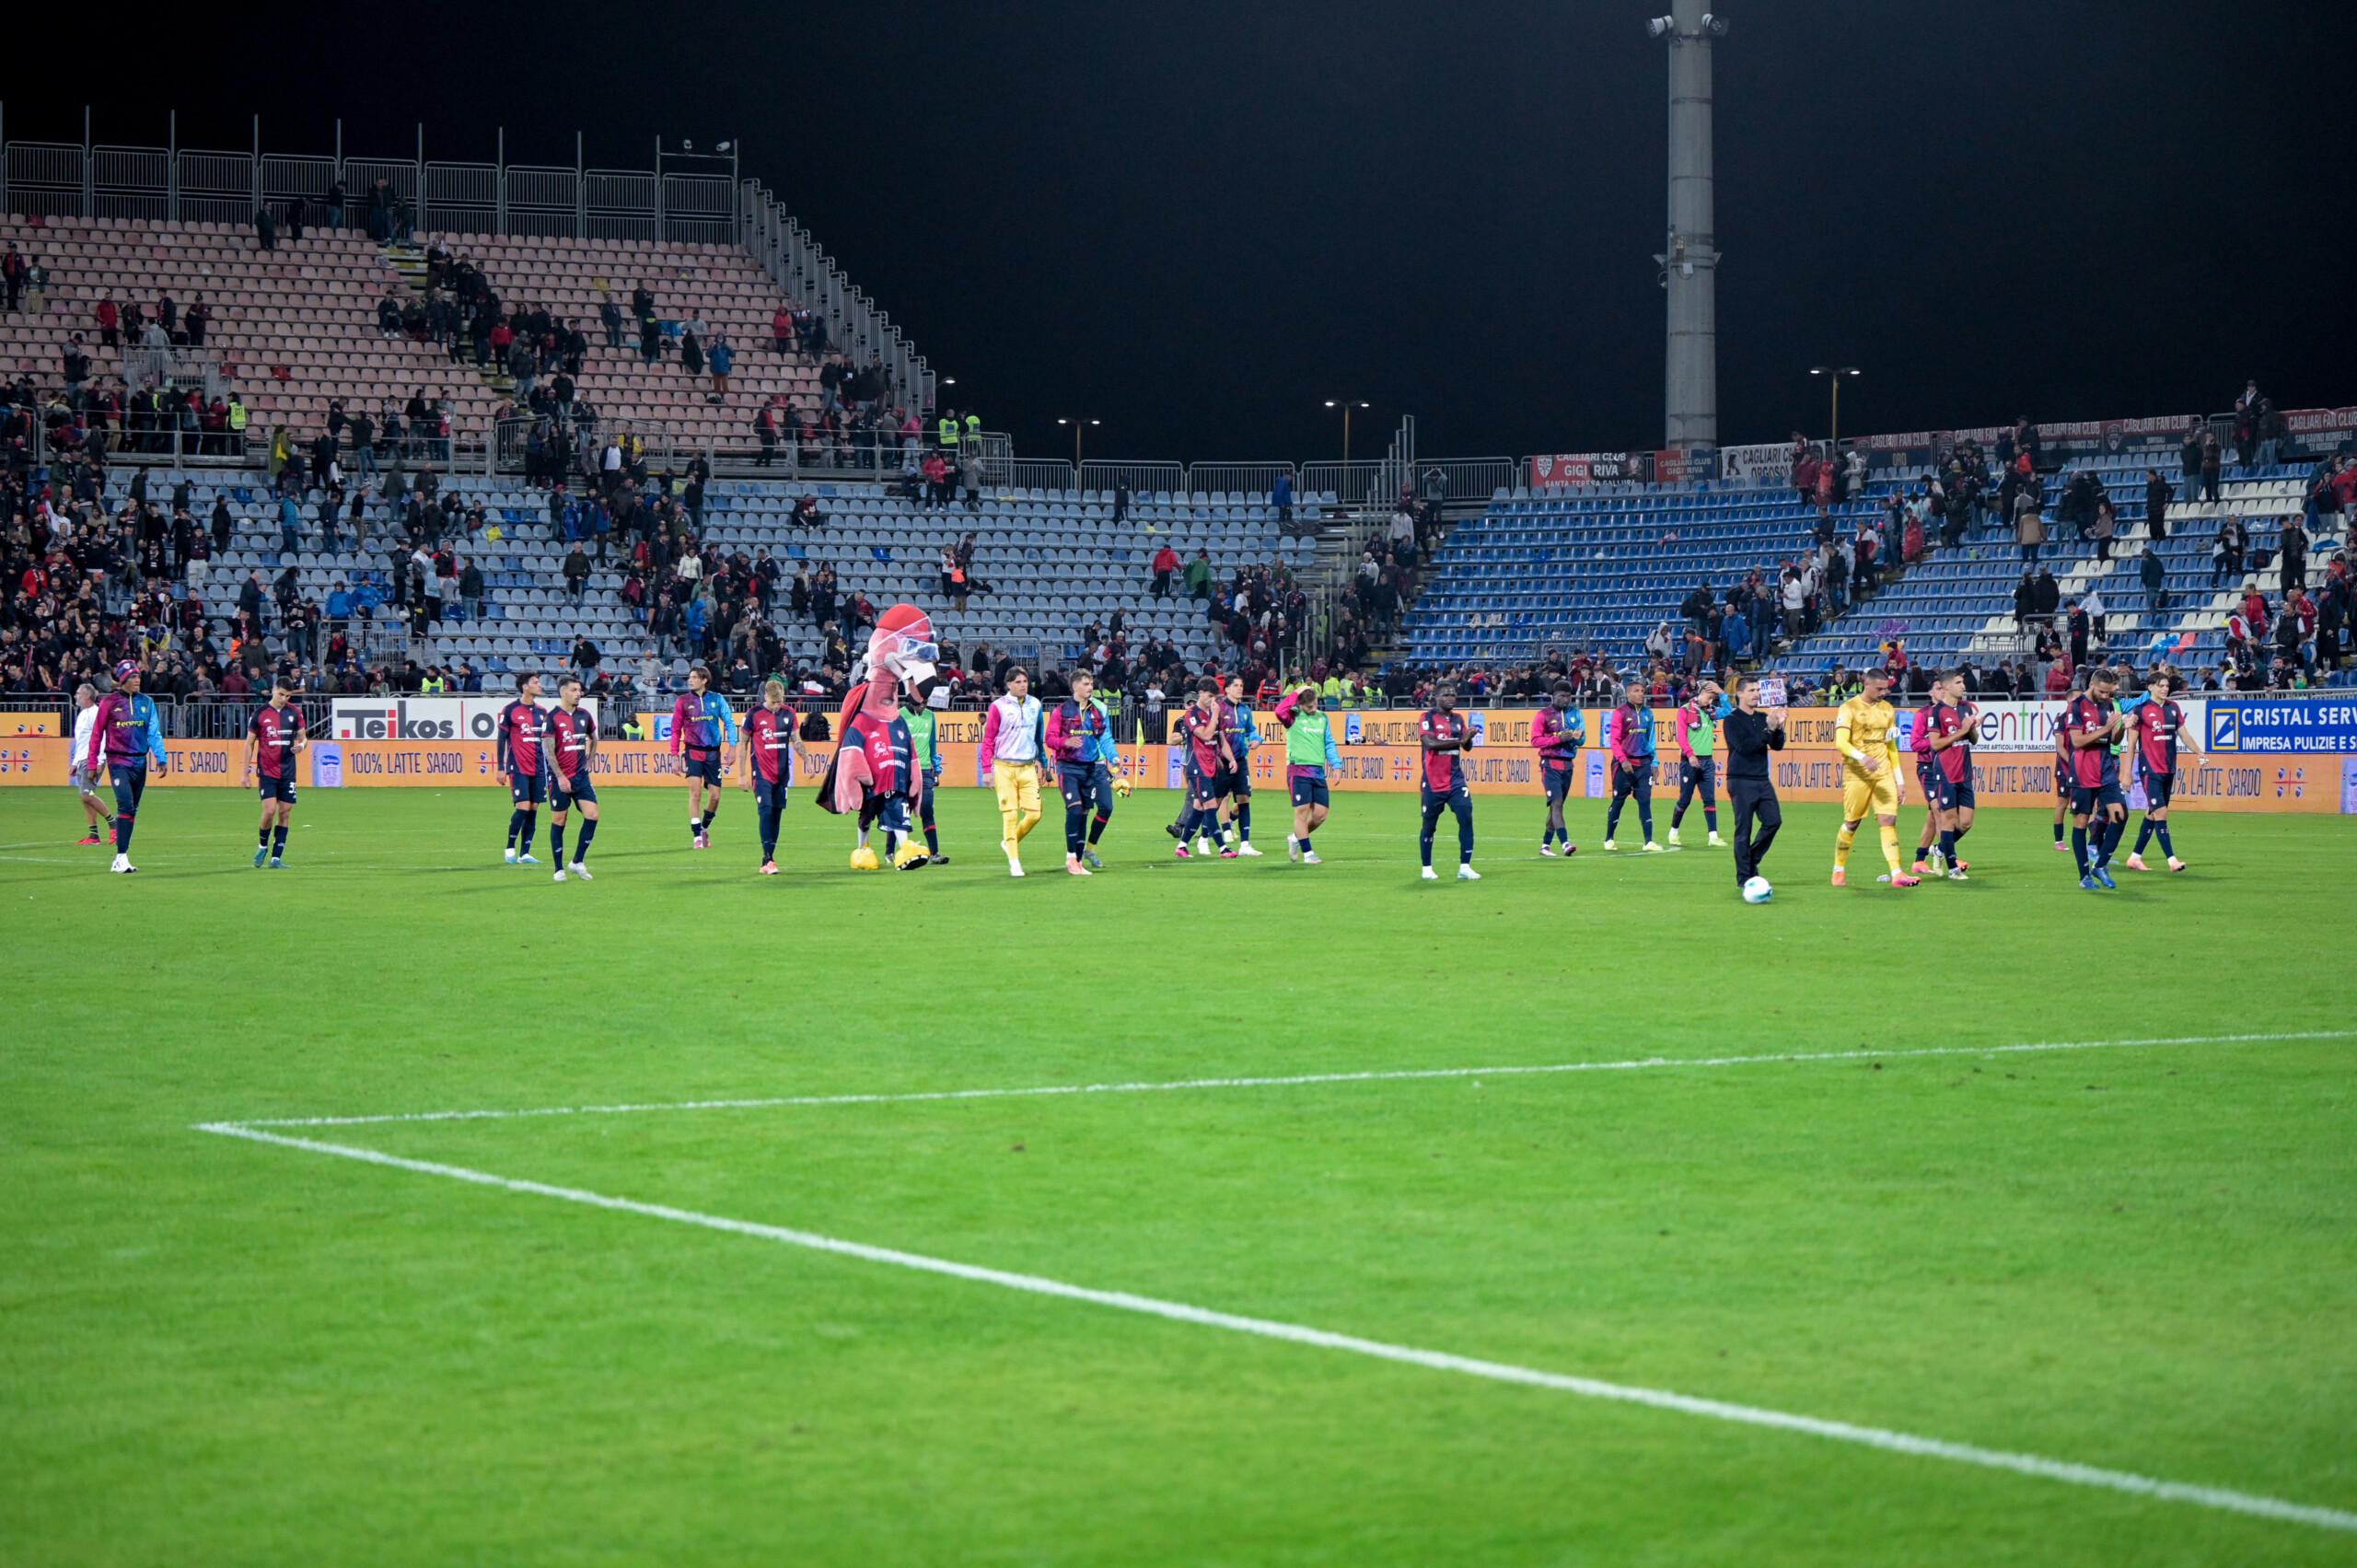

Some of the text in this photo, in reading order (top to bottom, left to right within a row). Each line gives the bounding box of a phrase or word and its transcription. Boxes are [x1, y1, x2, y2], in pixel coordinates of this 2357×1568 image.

[2038, 421, 2100, 437] CAGLIARI FAN CLUB
[2124, 414, 2189, 433] CAGLIARI FAN CLUB
[2289, 411, 2357, 431] CAGLIARI FAN CLUB
[1871, 431, 1931, 448] CAGLIARI FAN CLUB
[1955, 428, 1984, 443] CAGLIARI
[1985, 427, 1998, 442] FAN
[2295, 434, 2305, 445] SAN
[2326, 429, 2353, 443] MONREALE
[1557, 451, 1627, 463] CAGLIARI CLUB
[1660, 457, 1712, 468] CAGLIARI CLUB
[1743, 447, 1782, 465] CAGLIARI
[1893, 452, 1907, 466] ORO
[1564, 464, 1619, 477] GIGI RIVA
[1666, 466, 1703, 475] GIGI RIVA
[1545, 480, 1570, 488] SANTA
[337, 700, 454, 738] Teikos
[2241, 707, 2312, 726] CRISTAL
[936, 723, 963, 742] ATTE
[1365, 722, 1381, 742] 100%
[1383, 722, 1400, 742] LATTE
[1404, 722, 1421, 742] SARD
[1490, 722, 1507, 743] 100%
[1509, 722, 1529, 742] LATTE
[1790, 721, 1813, 743] LATTE
[1816, 720, 1836, 743] SARD
[2242, 736, 2357, 750] IMPRESA PULIZIE E S
[190, 751, 227, 773] SARDO
[351, 752, 382, 773] 100%
[387, 752, 422, 773] LATTE
[426, 752, 463, 773] SARDO
[616, 752, 648, 773] LATTE
[653, 752, 689, 774] SARO
[1341, 757, 1359, 779] ATTE
[1362, 757, 1384, 780] SARDO
[1460, 759, 1530, 784] 00% LATTE SARDO
[1664, 761, 1679, 786] SAR
[1778, 762, 1802, 788] 100%
[1805, 762, 1831, 789] LATTE
[1989, 765, 2018, 794] LATTE
[2021, 765, 2051, 794] SARDO
[2190, 767, 2223, 796] LATTE
[2226, 767, 2262, 796] SARDO
[1461, 786, 1469, 797] 7
